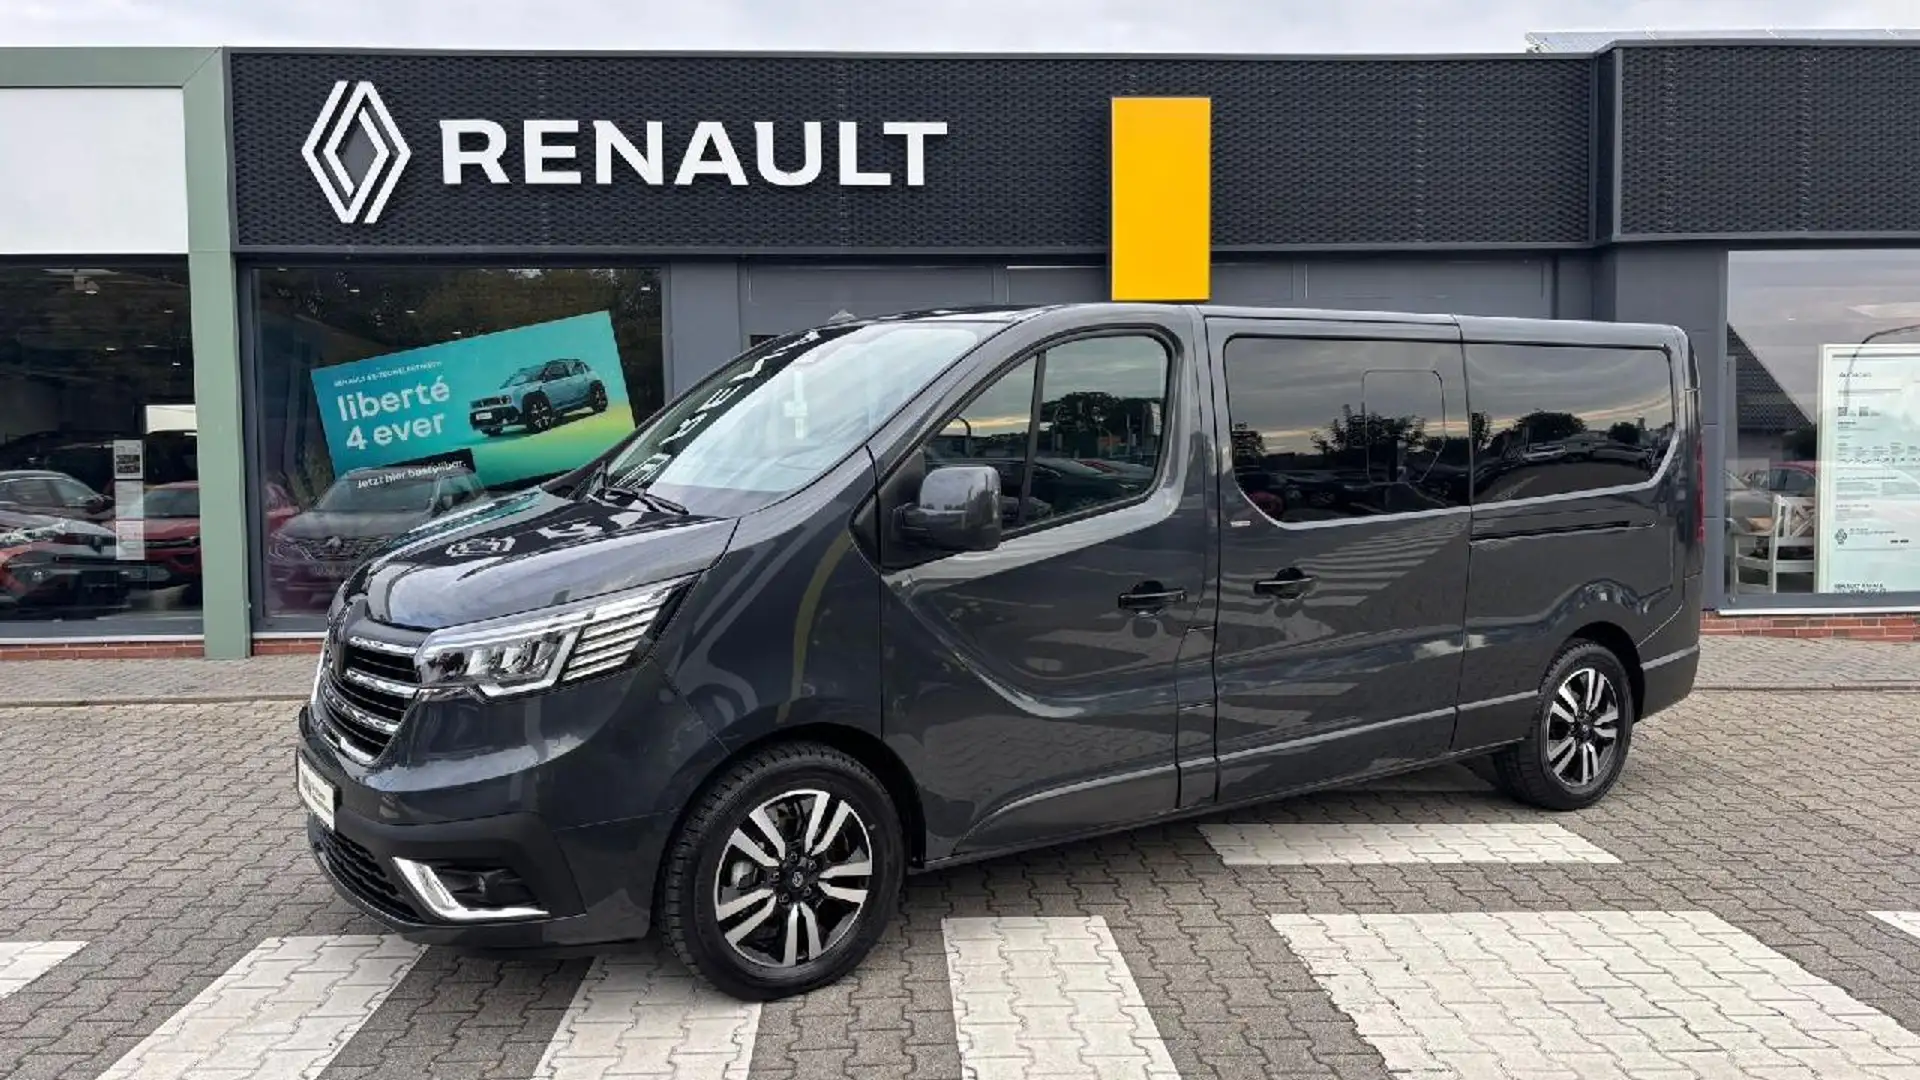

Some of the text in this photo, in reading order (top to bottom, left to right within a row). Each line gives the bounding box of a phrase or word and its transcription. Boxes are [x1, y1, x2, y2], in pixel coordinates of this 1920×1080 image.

[440, 119, 948, 187] RENAULT
[337, 375, 450, 422] liberté
[346, 413, 445, 450] 4 ever
